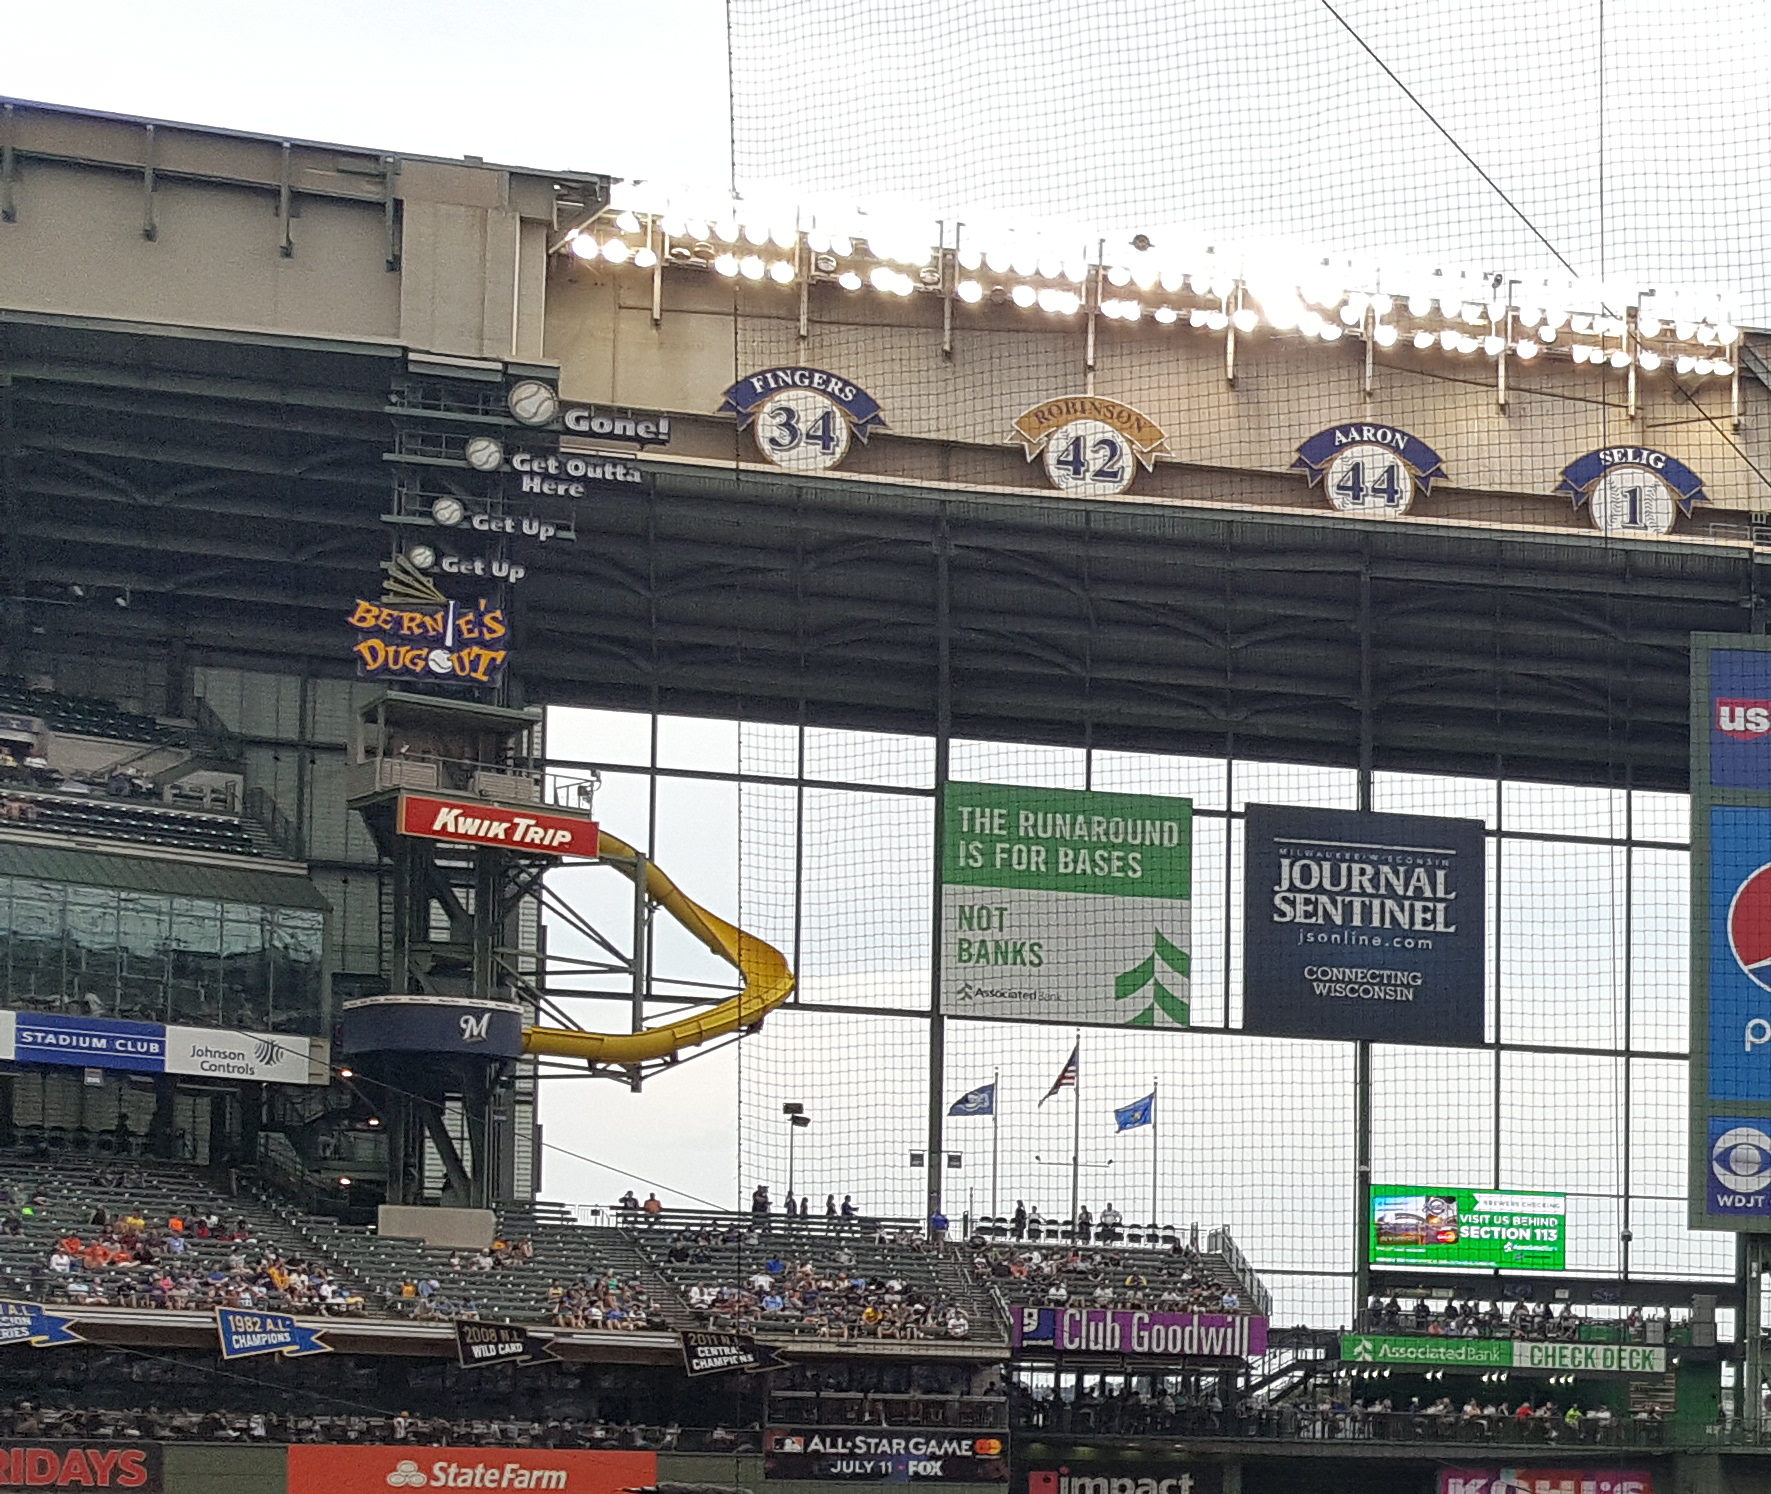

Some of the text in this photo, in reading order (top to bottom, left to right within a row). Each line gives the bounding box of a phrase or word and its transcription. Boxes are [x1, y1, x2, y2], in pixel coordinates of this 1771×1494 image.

[750, 368, 856, 403] FINGERS
[564, 408, 670, 444] Gone!
[1034, 396, 1147, 434] ROBINSON
[768, 406, 840, 456] 34
[1333, 426, 1409, 450] AARON
[512, 452, 642, 485] Get Outta
[1055, 436, 1125, 481] 42
[1600, 448, 1666, 470] SELIG
[522, 476, 586, 499] Here
[1336, 461, 1400, 505] 44
[353, 638, 506, 682] DUGOUT
[959, 806, 1178, 848] THE RUNAROUND
[959, 841, 1142, 878] IS FOR BASES
[1274, 858, 1456, 901] JOURNAL
[957, 905, 1008, 933] NOT
[1274, 893, 1456, 933] SENTINEL
[957, 938, 1043, 967] BANKS
[1298, 929, 1433, 951] jsonline.com
[1304, 966, 1423, 986] CONNECTING
[1313, 981, 1414, 1001] WISCONSIN
[22, 1030, 160, 1054] STADIUM CLUB
[190, 1044, 246, 1062] Johnson
[200, 1058, 256, 1076] Controls
[1717, 1195, 1764, 1210] WDJT
[1460, 1227, 1558, 1241] SECTION 113
[228, 1314, 261, 1333] 1982
[1063, 1309, 1250, 1357] Club Goodwill
[233, 1332, 291, 1348] CHAMPIONS
[1379, 1345, 1654, 1370] Associated Bank CHECK DECK
[909, 1438, 972, 1456] GAME
[831, 1461, 943, 1476] JULY 11 FOX
